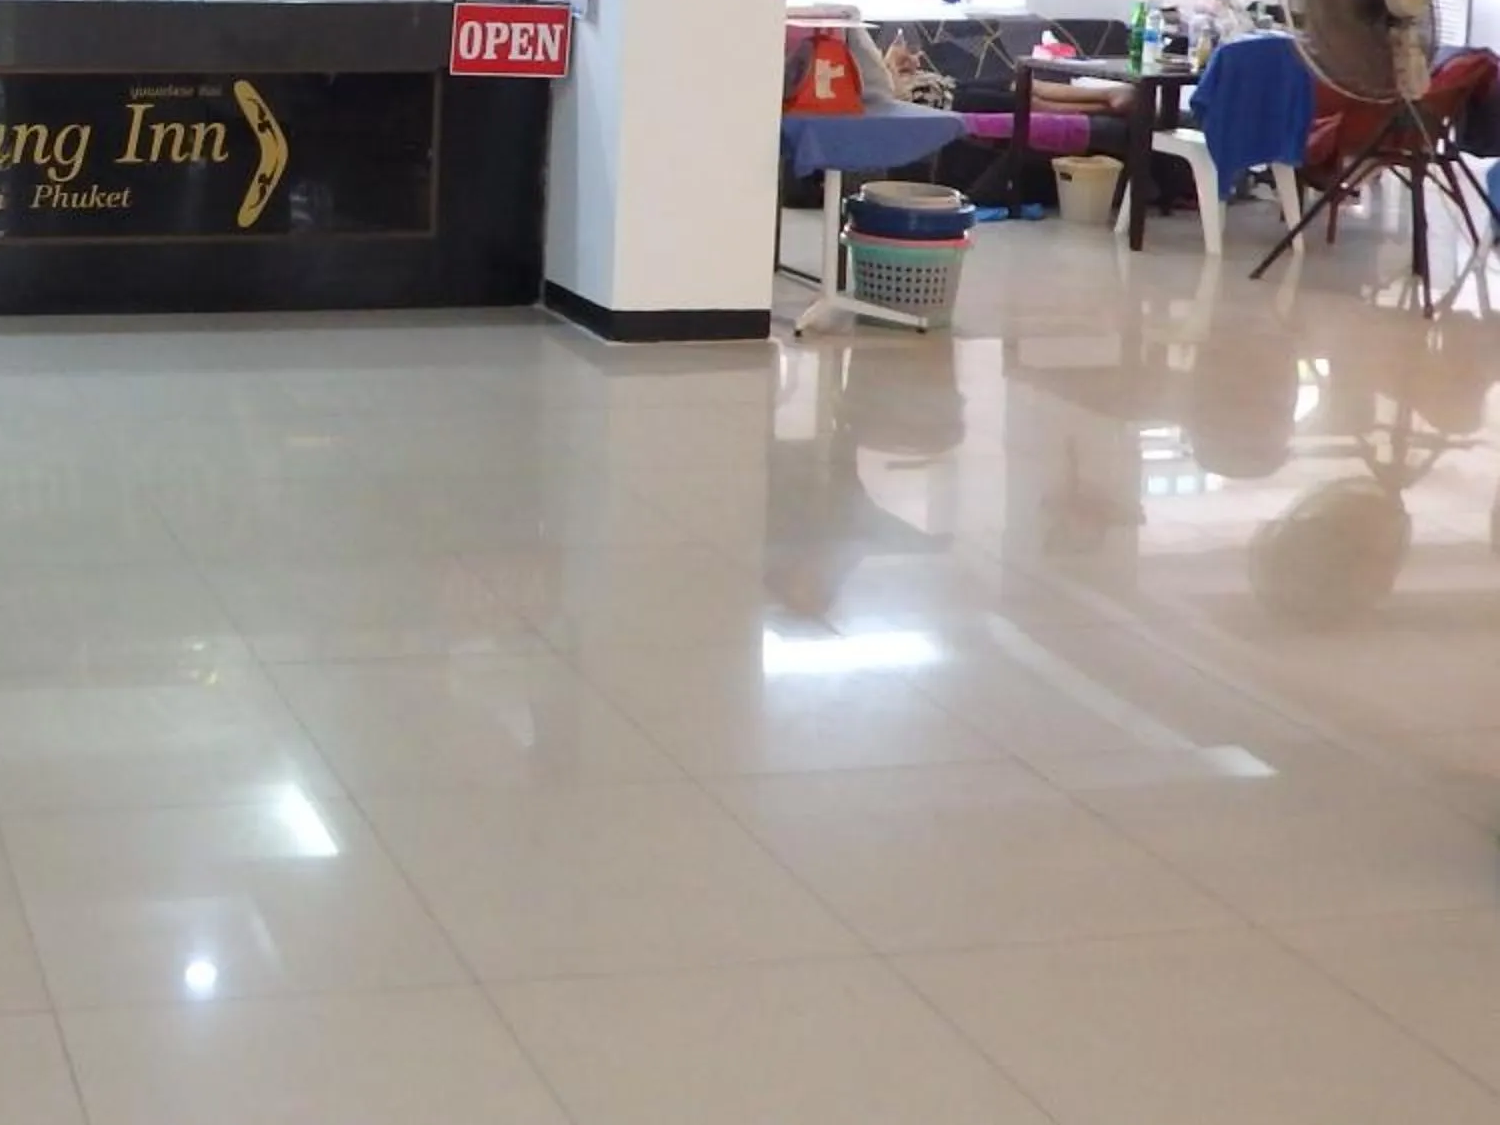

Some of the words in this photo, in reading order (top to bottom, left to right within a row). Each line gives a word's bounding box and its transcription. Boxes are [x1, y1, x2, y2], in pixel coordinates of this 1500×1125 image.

[458, 20, 564, 62] OPEN
[115, 102, 229, 164] Inn
[29, 182, 133, 210] Phuket
